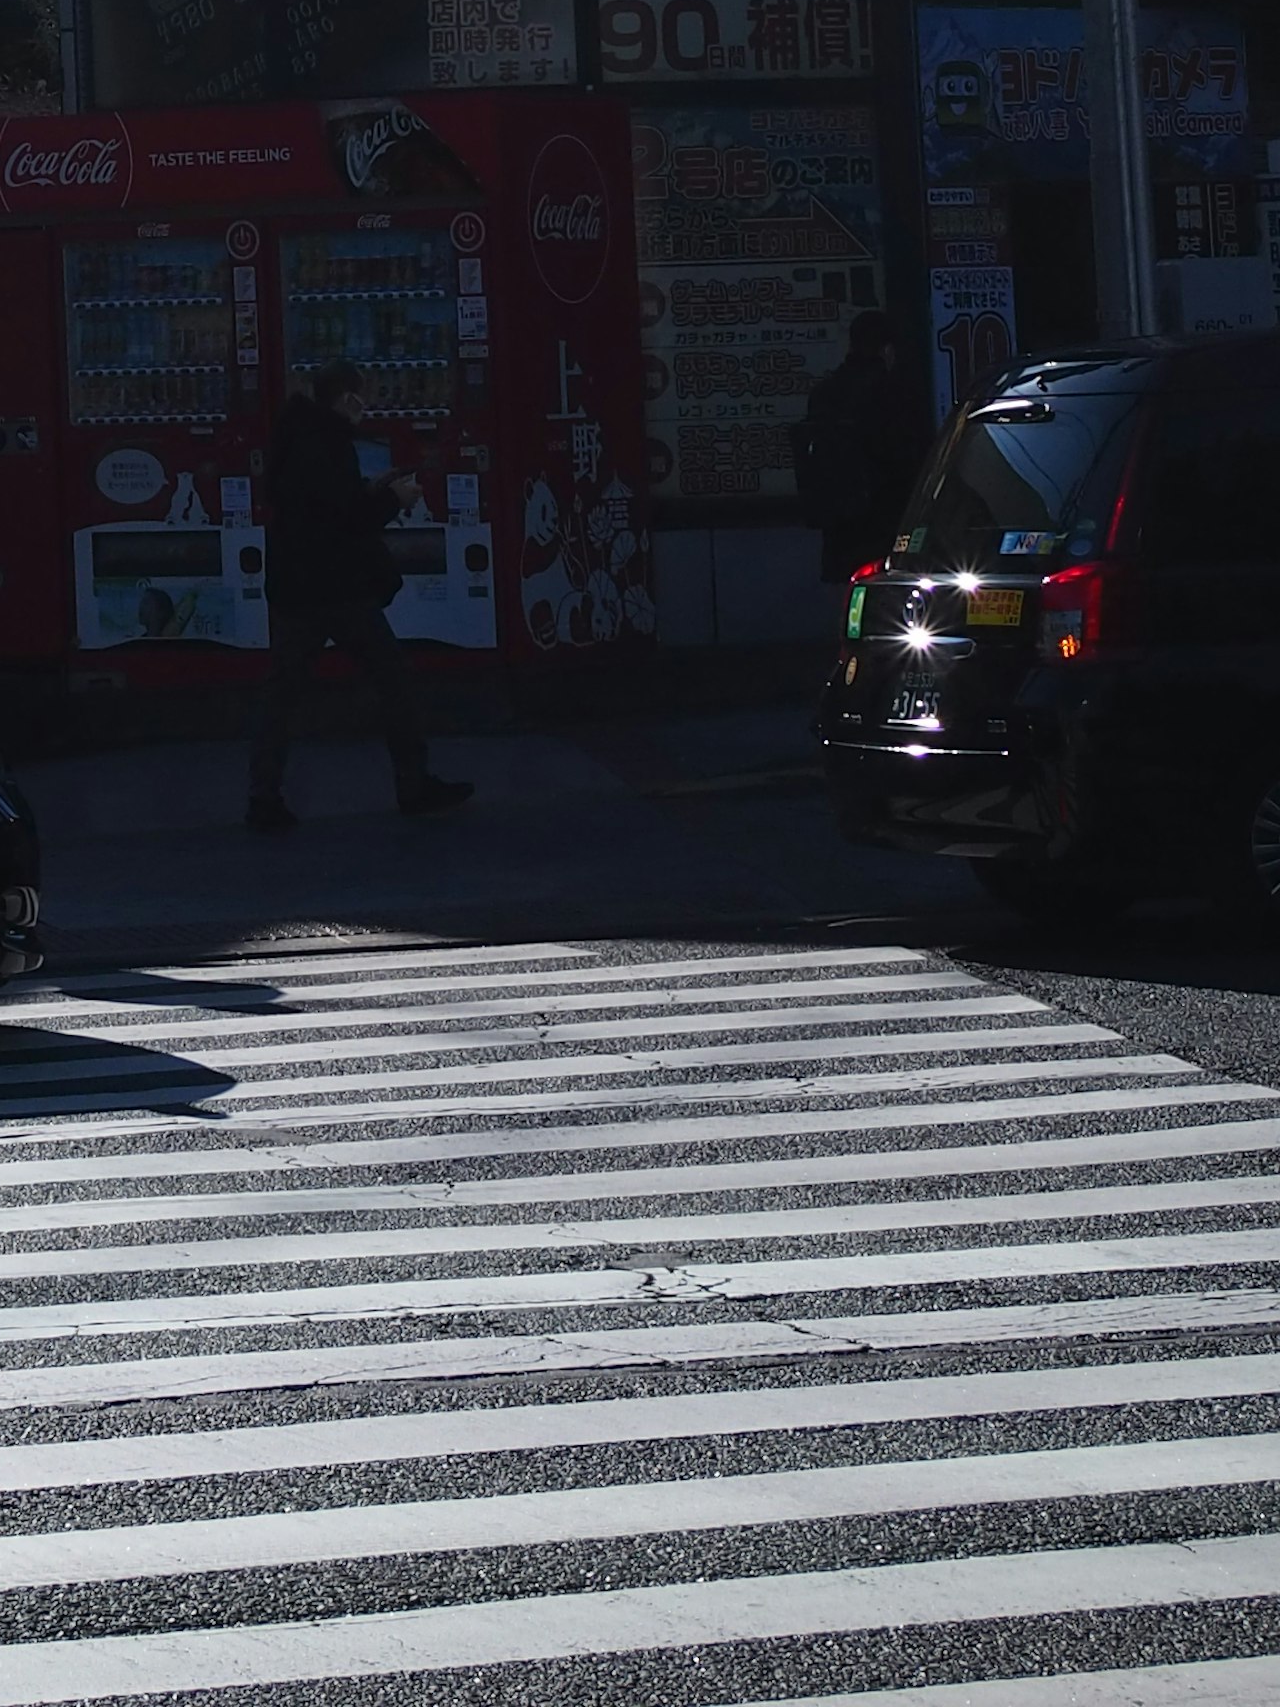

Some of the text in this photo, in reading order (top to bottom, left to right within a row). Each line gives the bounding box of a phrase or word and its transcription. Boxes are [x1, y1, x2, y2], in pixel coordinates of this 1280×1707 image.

[429, 24, 554, 56] 即時発行
[429, 56, 571, 86] 致します!
[1173, 112, 1244, 137] Camera
[3, 138, 292, 188] Coca-Cola TASTE THE FEELING
[532, 193, 602, 241] Coca-Cola
[545, 339, 602, 483] 上野
[677, 422, 792, 450] スマートフォ
[678, 446, 795, 472] スマートフォ
